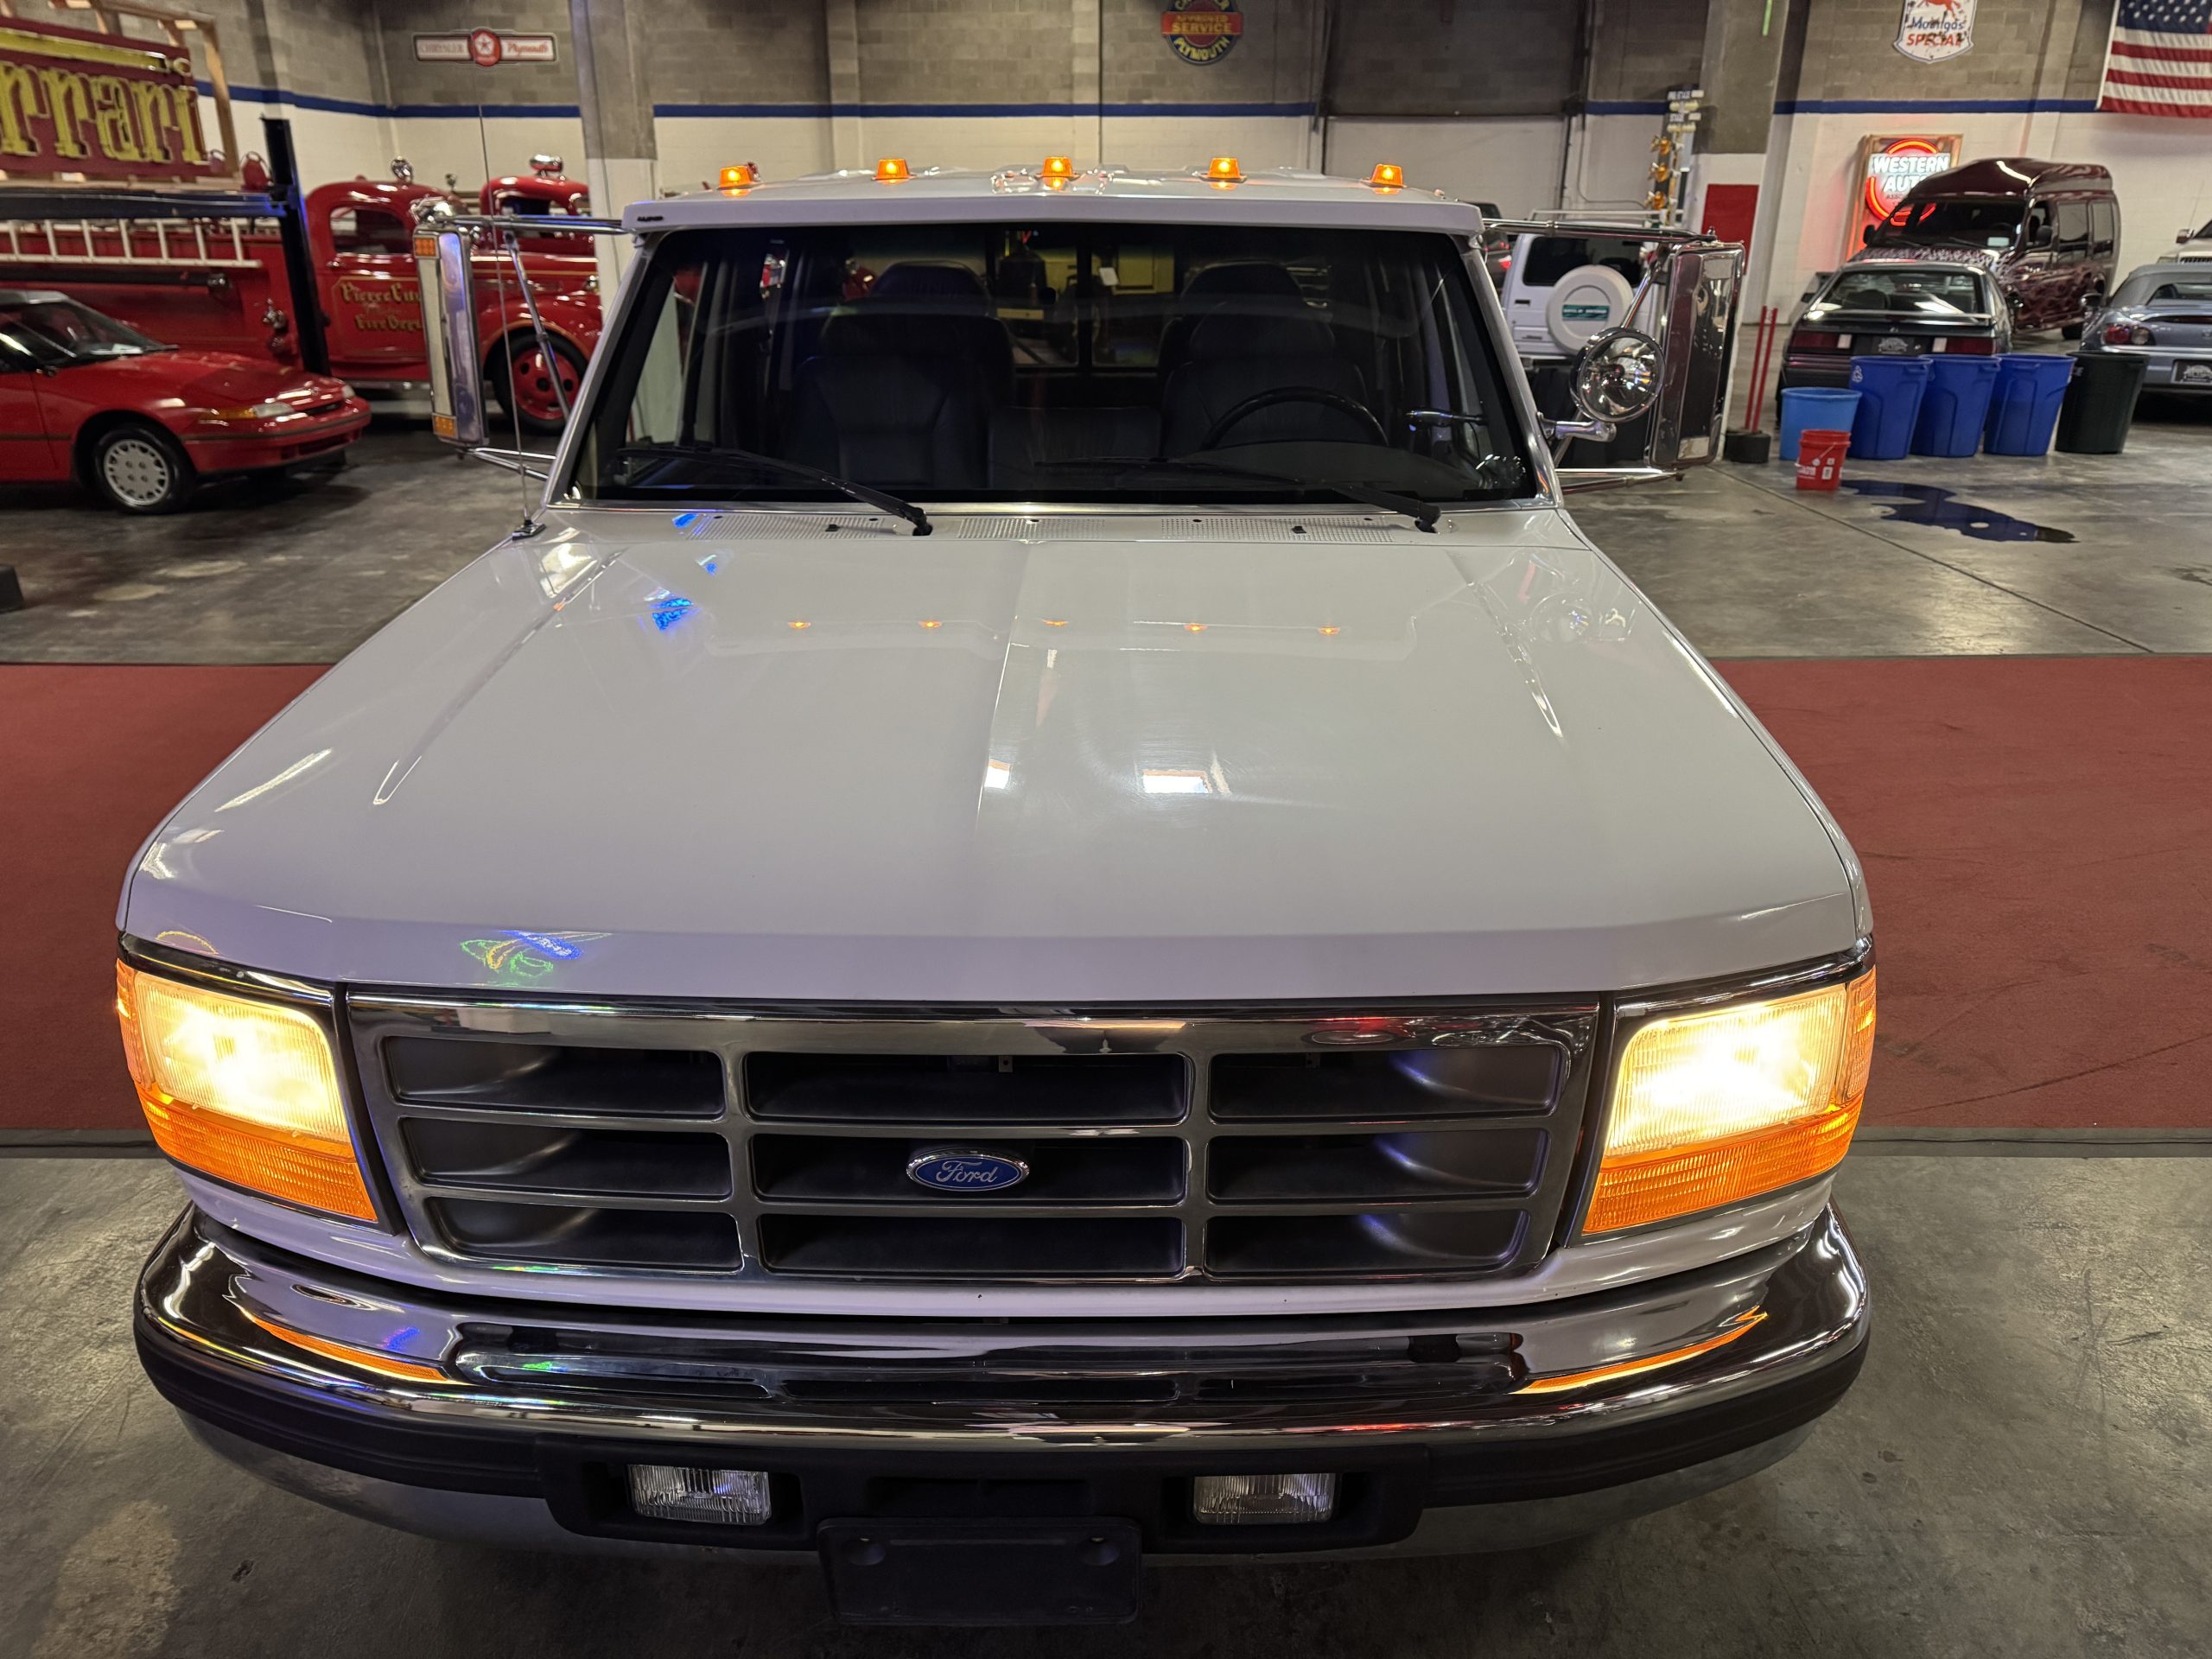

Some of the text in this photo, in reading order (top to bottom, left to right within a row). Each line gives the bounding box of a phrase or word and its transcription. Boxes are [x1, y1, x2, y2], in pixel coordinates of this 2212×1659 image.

[1172, 22, 1231, 33] SERVICE
[1173, 35, 1230, 60] PLYMOUTH
[1872, 156, 1949, 174] WESTERN
[936, 1160, 998, 1183] Ford
